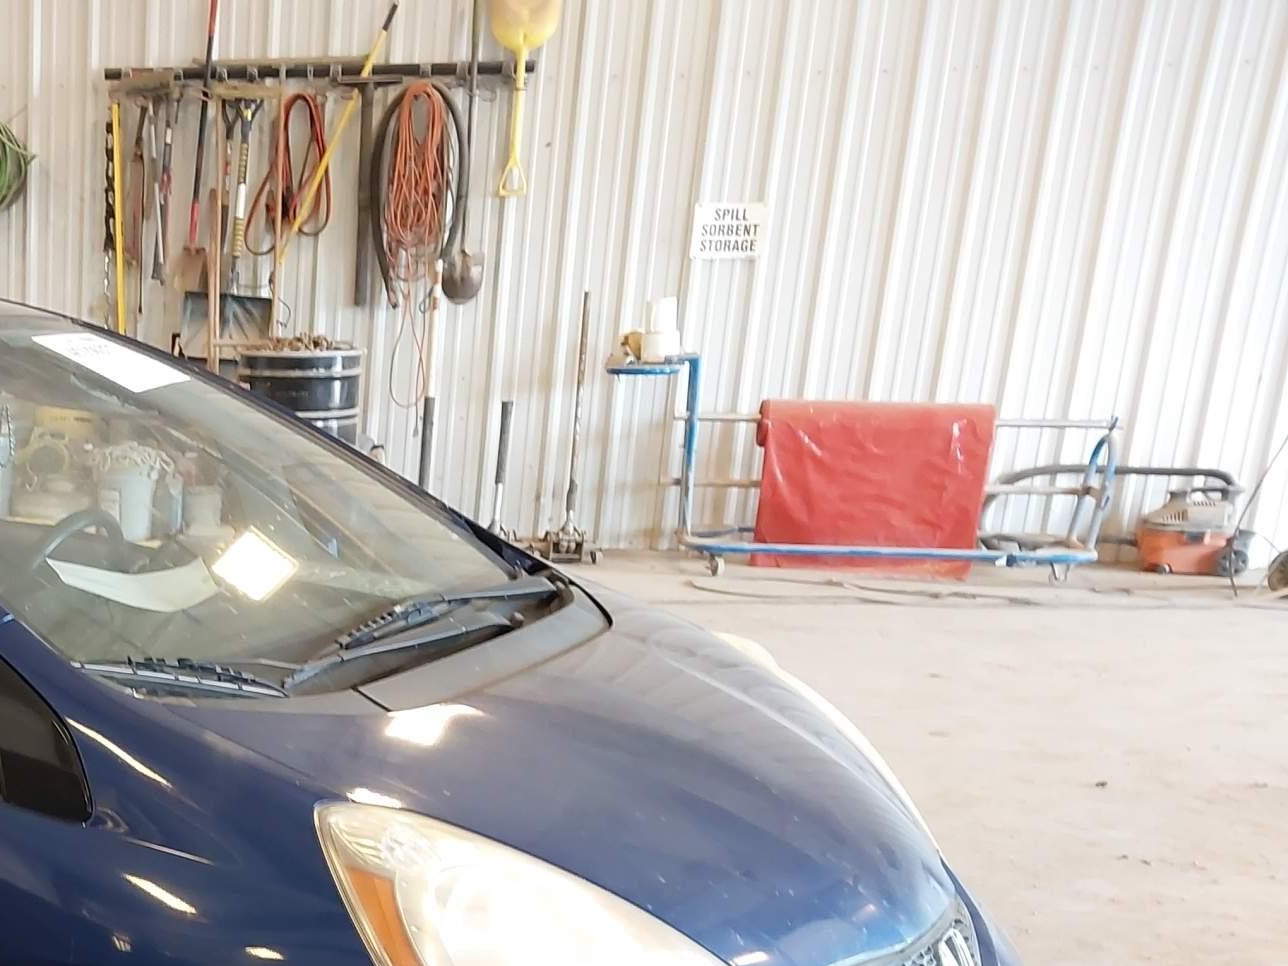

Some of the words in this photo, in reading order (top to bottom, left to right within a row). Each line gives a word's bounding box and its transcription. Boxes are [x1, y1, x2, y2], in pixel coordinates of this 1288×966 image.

[714, 208, 749, 222] SPILL
[701, 223, 760, 238] SORBENT
[699, 239, 757, 253] STORAGE
